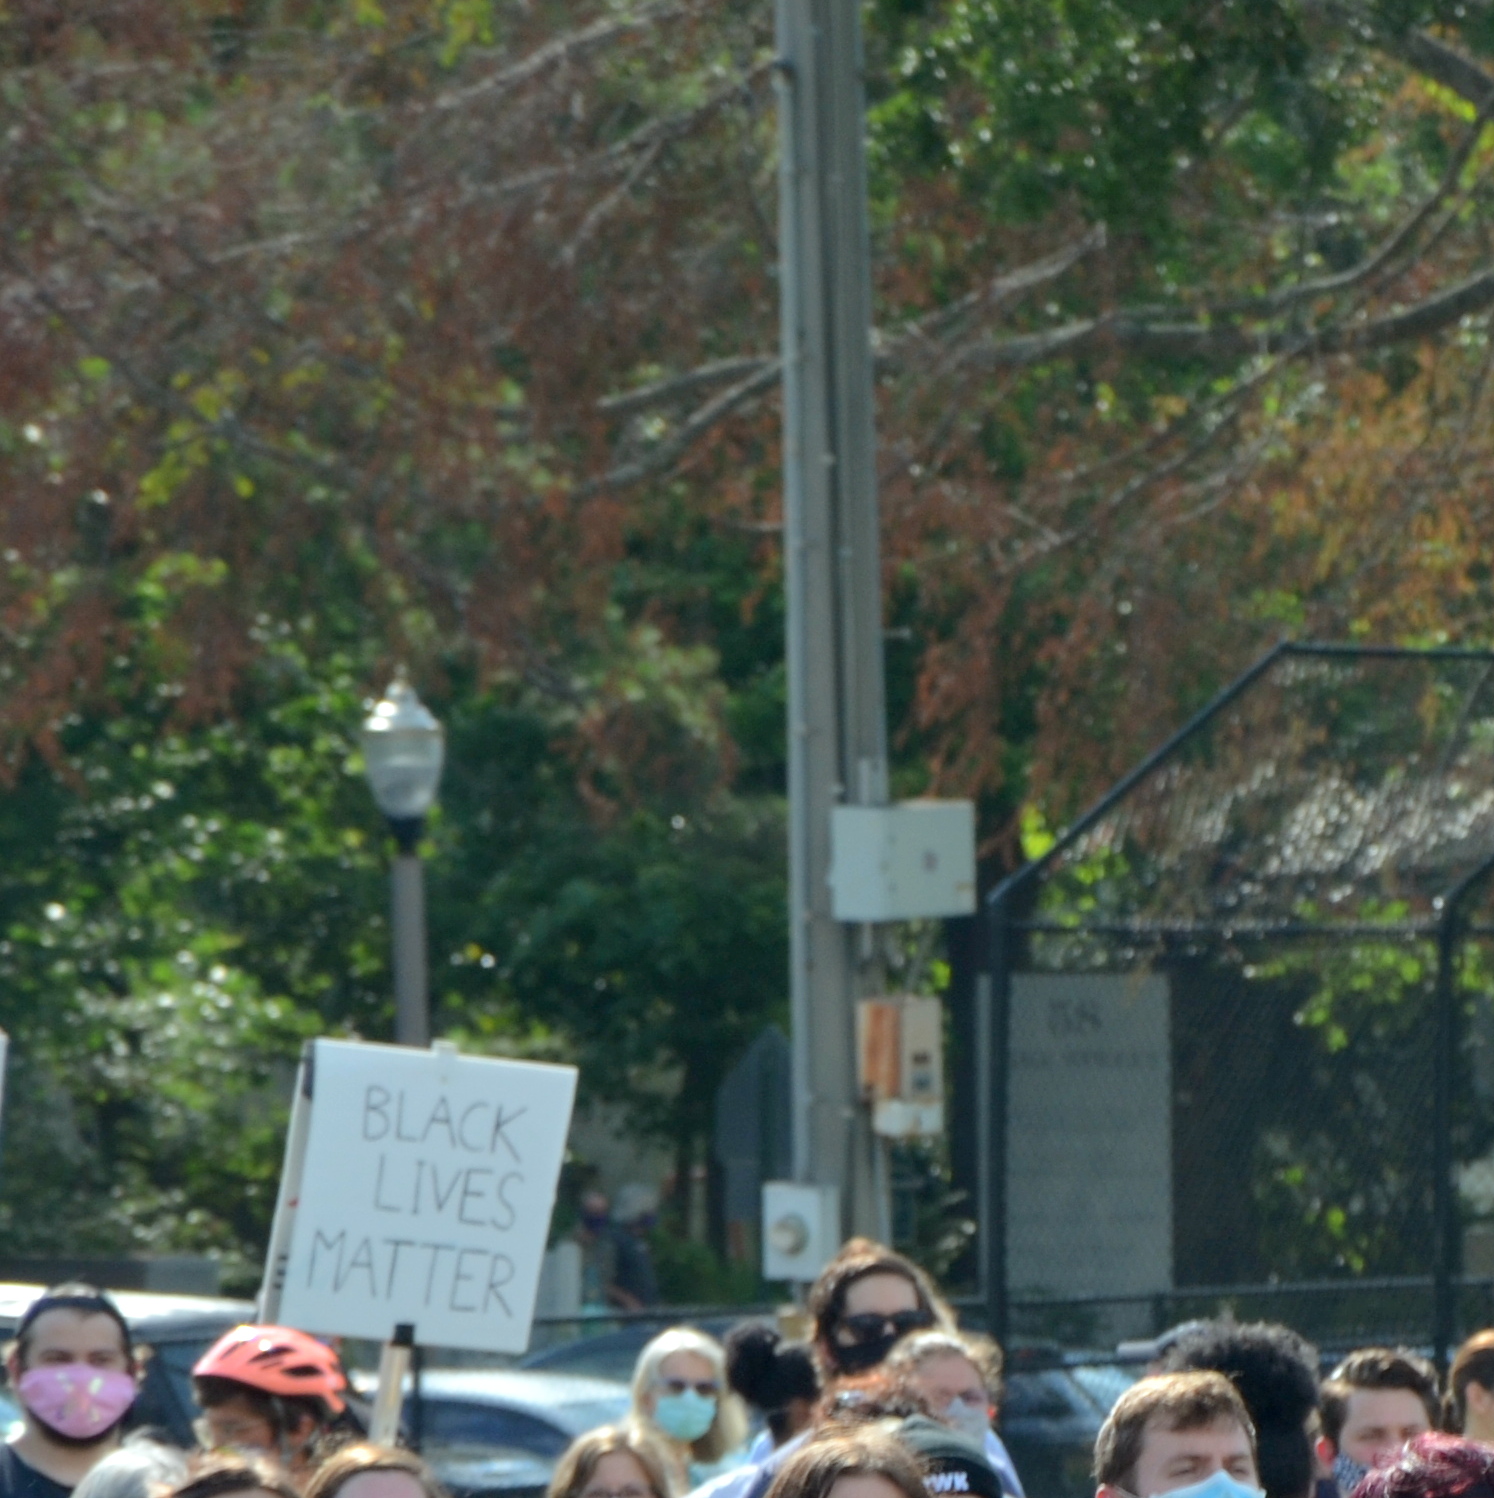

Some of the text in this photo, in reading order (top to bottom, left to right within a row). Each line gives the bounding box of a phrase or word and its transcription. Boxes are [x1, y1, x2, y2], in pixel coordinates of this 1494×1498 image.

[362, 1084, 528, 1164] BLACK
[374, 1154, 525, 1232] LIVES
[306, 1228, 516, 1318] MATTER
